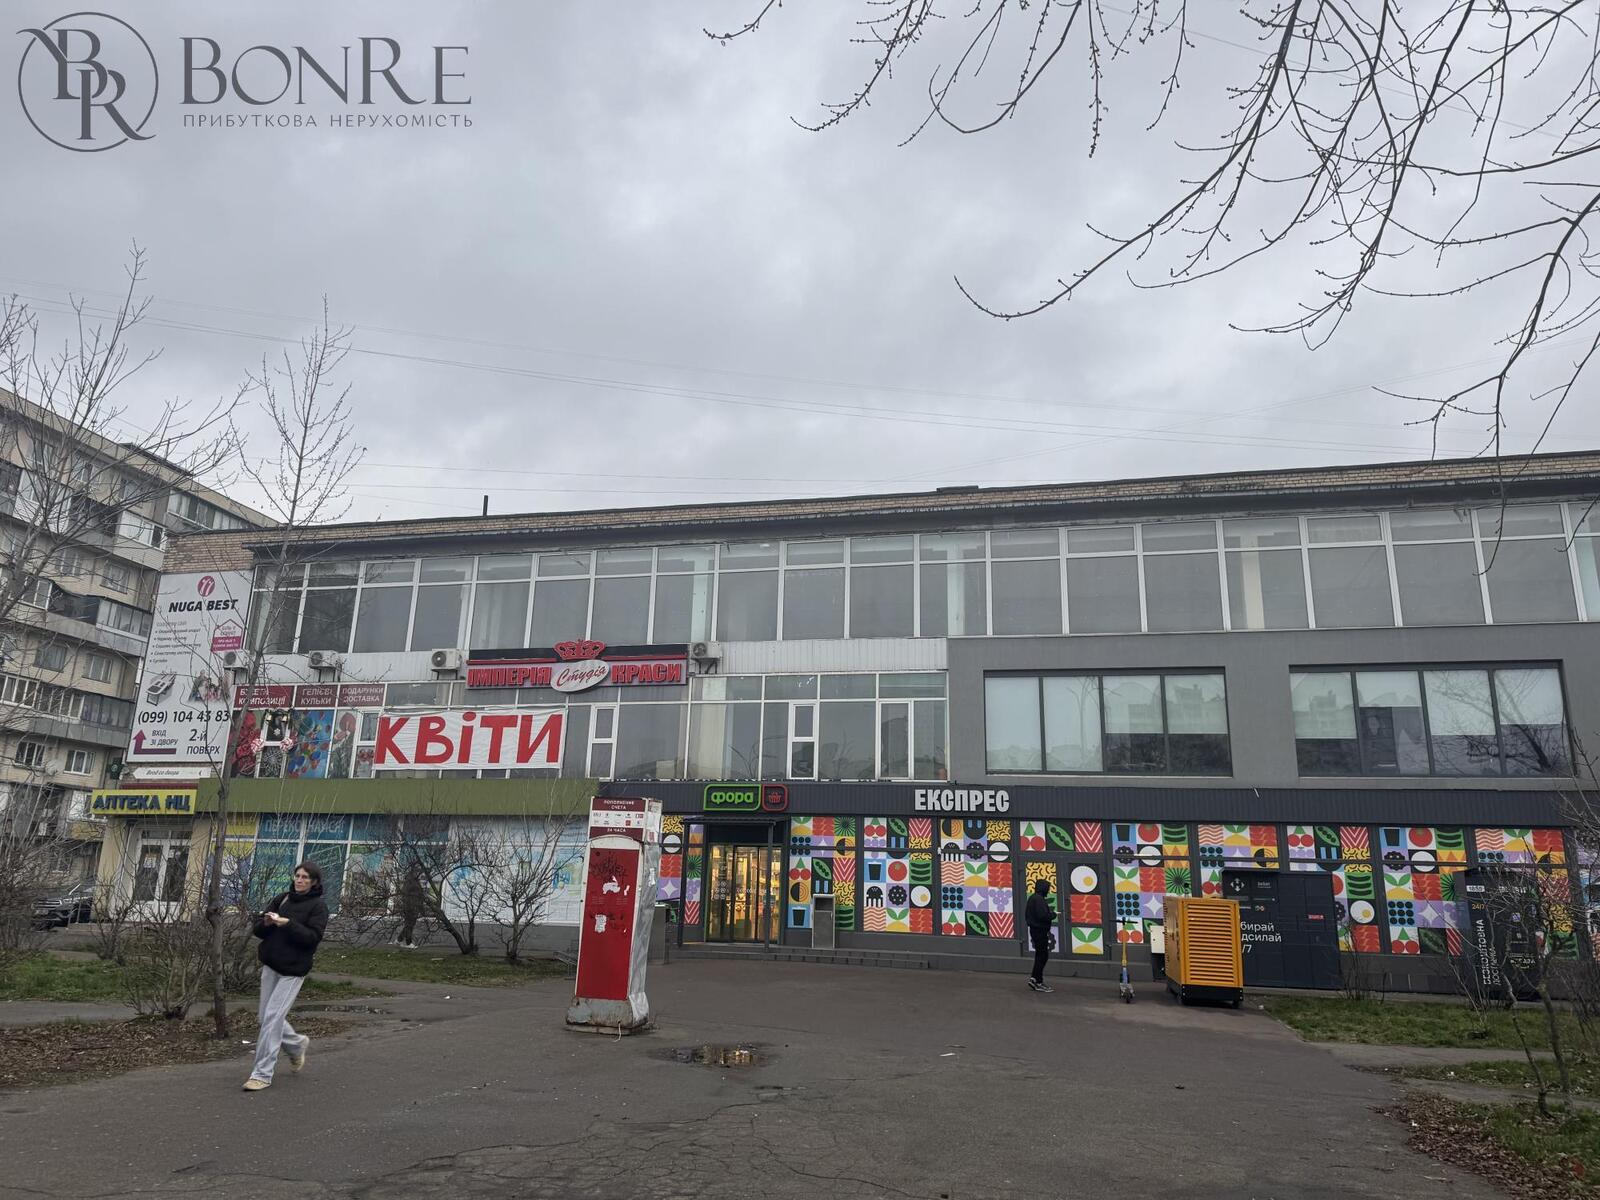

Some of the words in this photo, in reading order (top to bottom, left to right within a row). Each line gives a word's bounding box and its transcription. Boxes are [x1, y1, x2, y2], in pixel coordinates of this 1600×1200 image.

[168, 601, 203, 613] NUGA
[206, 599, 239, 611] BEST
[467, 666, 552, 687] ІМПЕРІЯ
[556, 665, 607, 688] Студія
[611, 663, 682, 684] КРАСИ
[300, 697, 332, 705] КУЛЬКИ
[138, 710, 168, 725] (099)
[172, 711, 193, 723] 104
[197, 710, 211, 723] 43
[215, 710, 230, 722] 83
[157, 739, 178, 747] ДВОРУ
[187, 745, 221, 755] ПОВЕРХ
[93, 794, 161, 810] АПТЕКА
[711, 791, 754, 805] фора
[914, 789, 1010, 812] ЕКСПРЕС
[1240, 921, 1275, 932] бирай
[1241, 933, 1282, 943] дсилай
